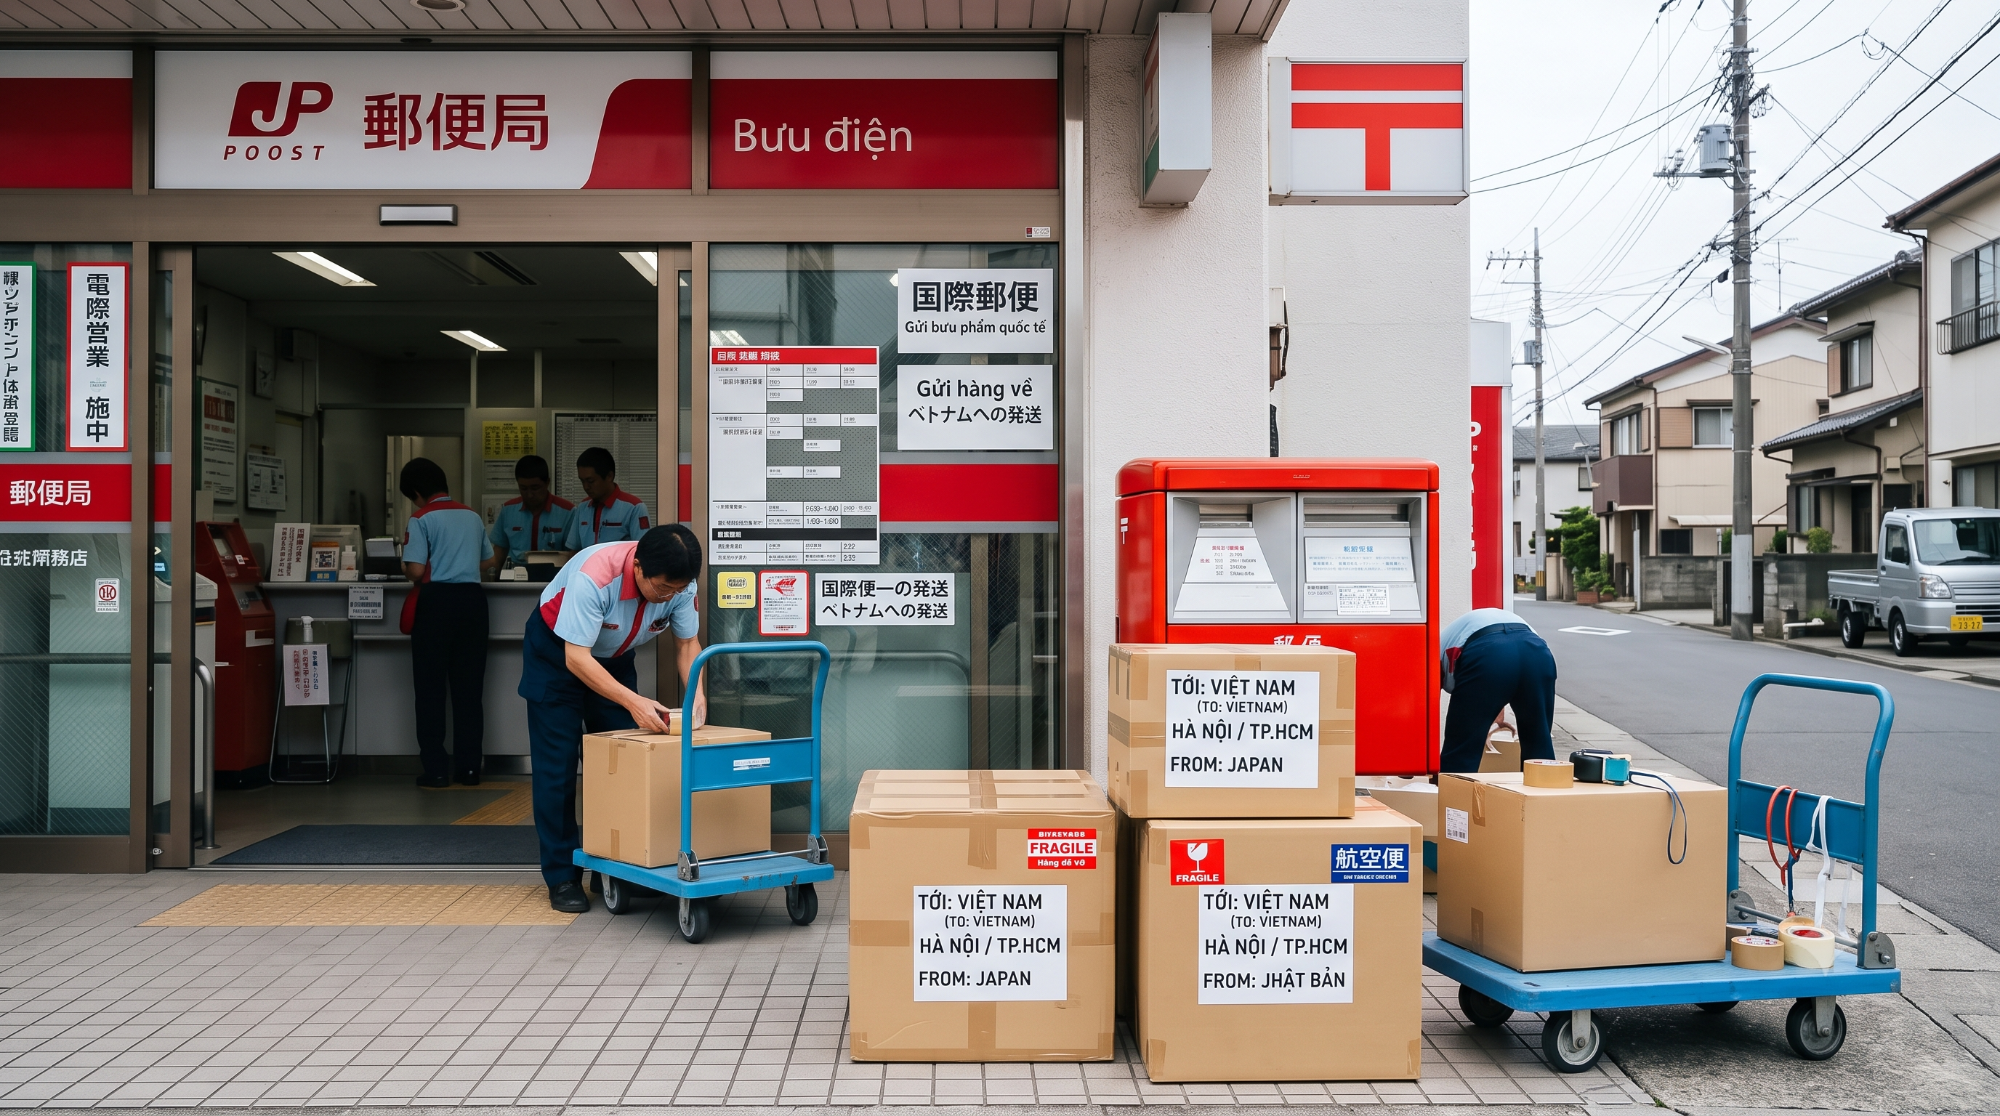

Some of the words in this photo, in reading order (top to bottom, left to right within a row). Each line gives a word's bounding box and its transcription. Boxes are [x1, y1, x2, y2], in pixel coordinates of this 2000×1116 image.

[363, 92, 549, 151] 郵便局
[735, 118, 810, 152] Bưu
[825, 117, 912, 160] điện
[224, 146, 324, 160] POOST
[913, 281, 1039, 312] 国際郵便
[86, 273, 110, 368] 電際営業
[905, 320, 928, 333] Gửi
[932, 321, 957, 333] bưu
[961, 319, 996, 336] phẩm
[1000, 320, 1030, 336] quốc
[1033, 319, 1047, 333] tế
[917, 379, 951, 397] Gửi
[958, 380, 1005, 402] hàng
[1011, 378, 1033, 397] về
[86, 396, 110, 443] 施中
[908, 406, 1042, 424] ベトナムへの発送
[10, 480, 91, 506] 郵便局
[822, 603, 948, 619] ベトナムへの発送
[1171, 674, 1205, 695] TỚI:
[1211, 675, 1250, 698] VIỆT
[1256, 680, 1295, 695] NAM
[1197, 700, 1222, 714] (TO:
[1226, 700, 1288, 715] VIETNAM)
[1172, 719, 1196, 739] HÀ
[1202, 719, 1232, 743] NỘI
[1237, 722, 1245, 741] /
[1250, 724, 1313, 740] TP.HCM
[1171, 757, 1222, 772] FROM:
[1228, 757, 1283, 772] JAPAN
[1030, 842, 1093, 854] FRAGILE
[1335, 847, 1405, 870] 航空便
[1176, 874, 1220, 882] FRAGILE
[918, 889, 952, 910] TỚI:
[957, 889, 997, 913] VIỆT
[1003, 894, 1042, 910] NAM
[1204, 889, 1238, 910] TỚI:
[1244, 889, 1283, 913] VIỆT
[1289, 894, 1329, 910] NAM
[945, 915, 970, 929] (TO:
[973, 915, 1035, 929] VIETNAM)
[1231, 915, 1256, 929] (TO:
[1260, 915, 1322, 929] VIETNAM)
[920, 933, 944, 953] HÀ
[950, 933, 979, 957] NỘI
[985, 936, 992, 955] /
[997, 938, 1061, 954] TP.HCM
[1205, 934, 1230, 955] HÀ
[1236, 934, 1266, 959] NỘI
[1271, 937, 1279, 956] /
[1284, 938, 1348, 954] TP.HCM
[919, 971, 971, 987] FROM:
[976, 971, 1031, 986] JAPAN
[1204, 973, 1256, 988] FROM:
[1261, 968, 1305, 992] JHẬT
[1310, 967, 1345, 988] BẢN
